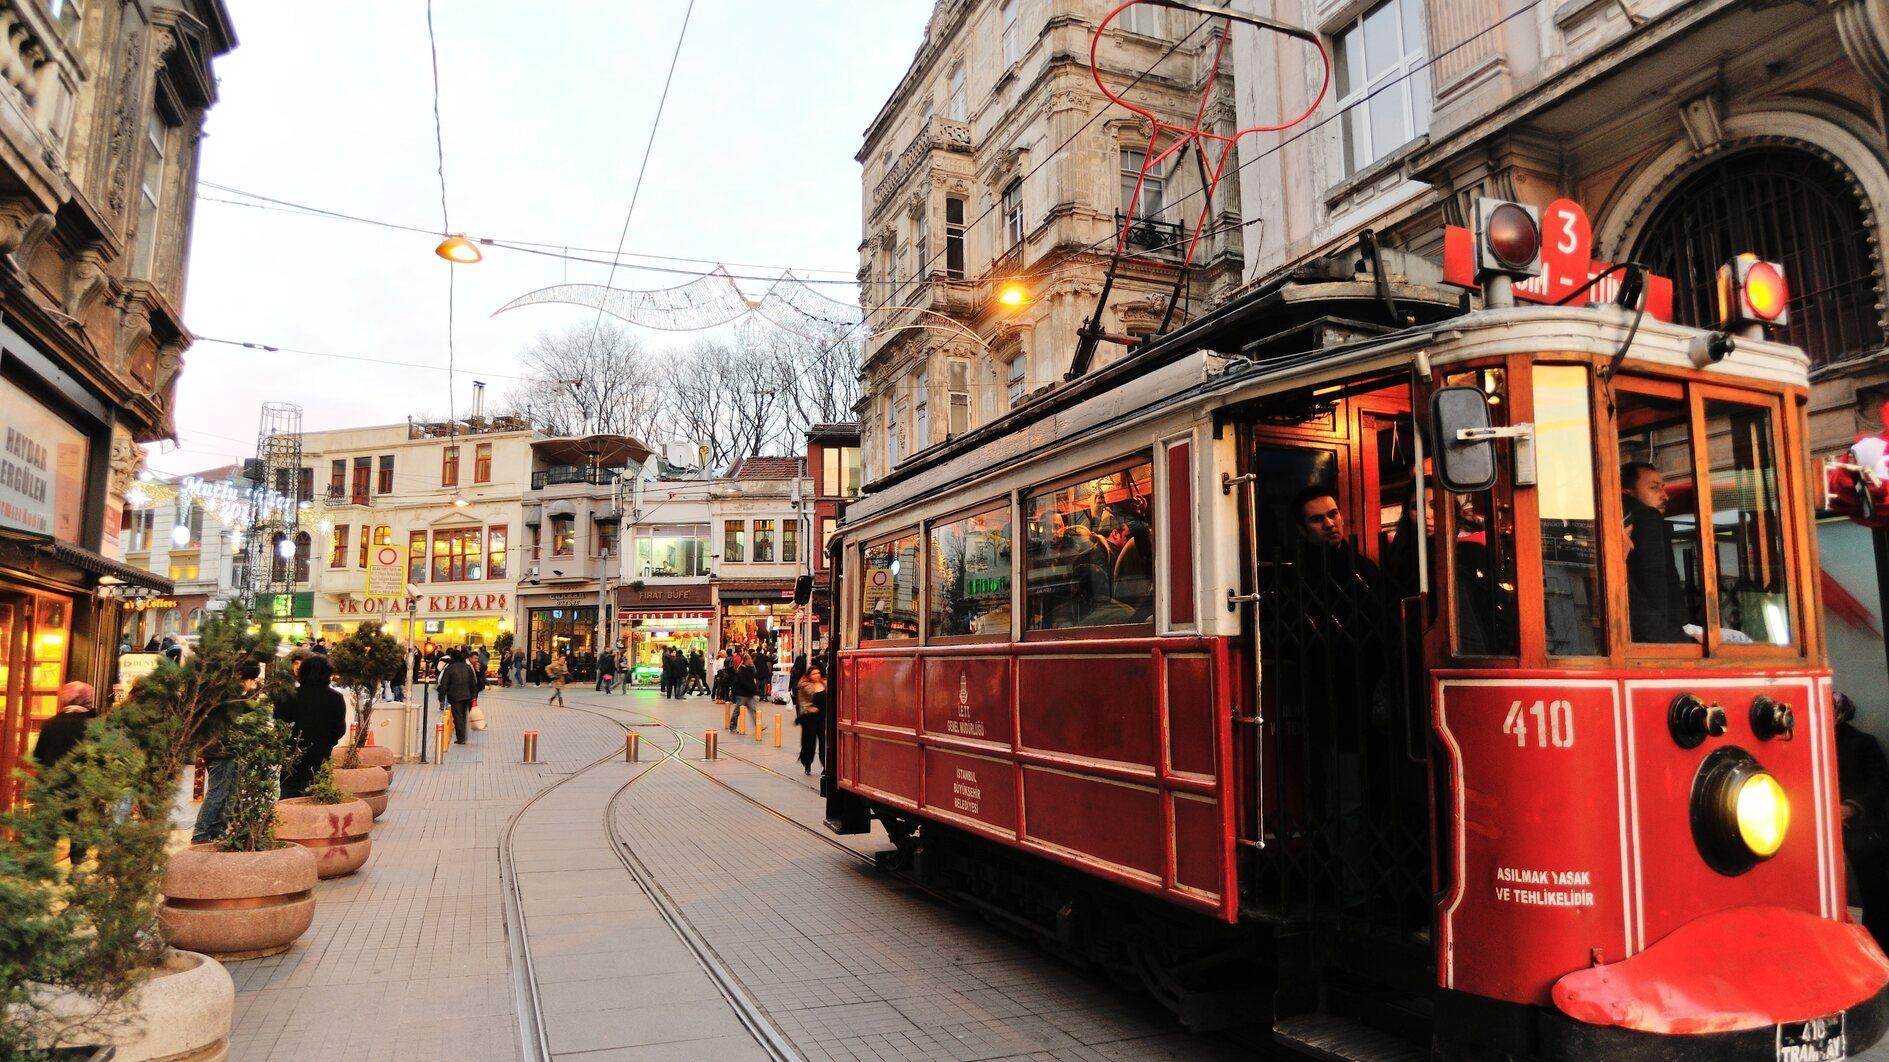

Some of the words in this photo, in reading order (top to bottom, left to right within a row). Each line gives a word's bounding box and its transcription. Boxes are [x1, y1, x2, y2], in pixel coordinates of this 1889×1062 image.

[1557, 210, 1577, 254] 3
[6, 426, 48, 472] HAYDAR
[0, 458, 47, 504] ERGÜLEN
[428, 594, 496, 612] KEBAP
[640, 591, 663, 600] FIRAT
[667, 588, 690, 600] BÜFE
[946, 719, 960, 733] GENEL
[1502, 700, 1574, 748] 410
[956, 764, 977, 783] İSTANBUL
[1497, 867, 1549, 885] ASILMAK
[1551, 871, 1590, 885] YASAK
[1495, 887, 1510, 901] VE
[1513, 888, 1594, 906] TEHLİKELİDİR
